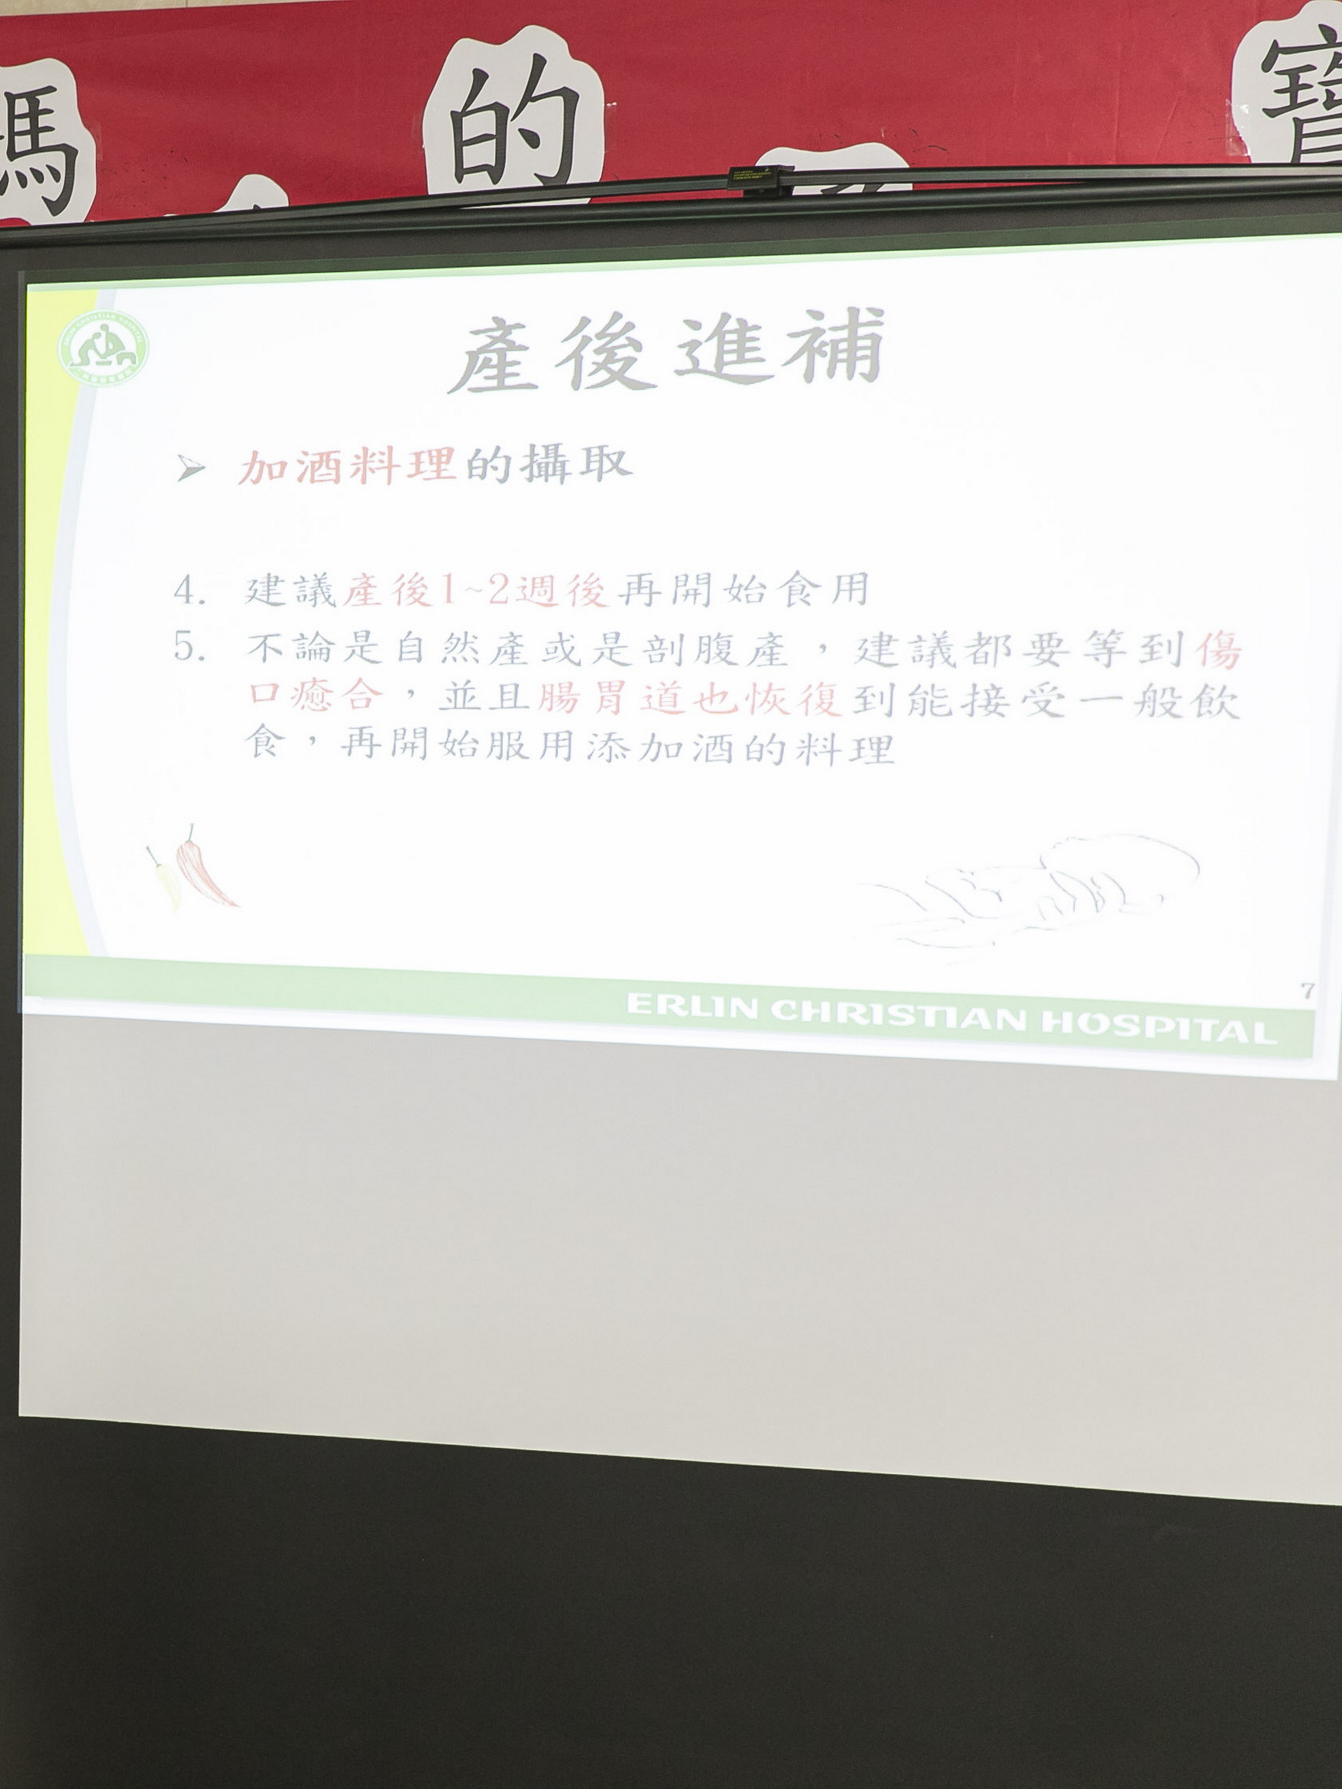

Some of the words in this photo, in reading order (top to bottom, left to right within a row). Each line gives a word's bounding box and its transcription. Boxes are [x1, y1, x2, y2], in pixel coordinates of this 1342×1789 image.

[450, 54, 579, 188] 的
[447, 306, 886, 396] 產後進補
[238, 443, 635, 486] 加酒料理的攝取
[174, 574, 207, 606] 4.
[244, 571, 870, 609] 建議產後1~2週後再開始食用
[174, 630, 207, 662] 5.
[244, 723, 897, 768] 食，再開始服用添加酒的料理
[1300, 982, 1316, 1000] 7
[625, 991, 759, 1020] ERLIN
[769, 999, 1028, 1031] CHRISTIAN
[1041, 1009, 1279, 1045] HOSPITAL
